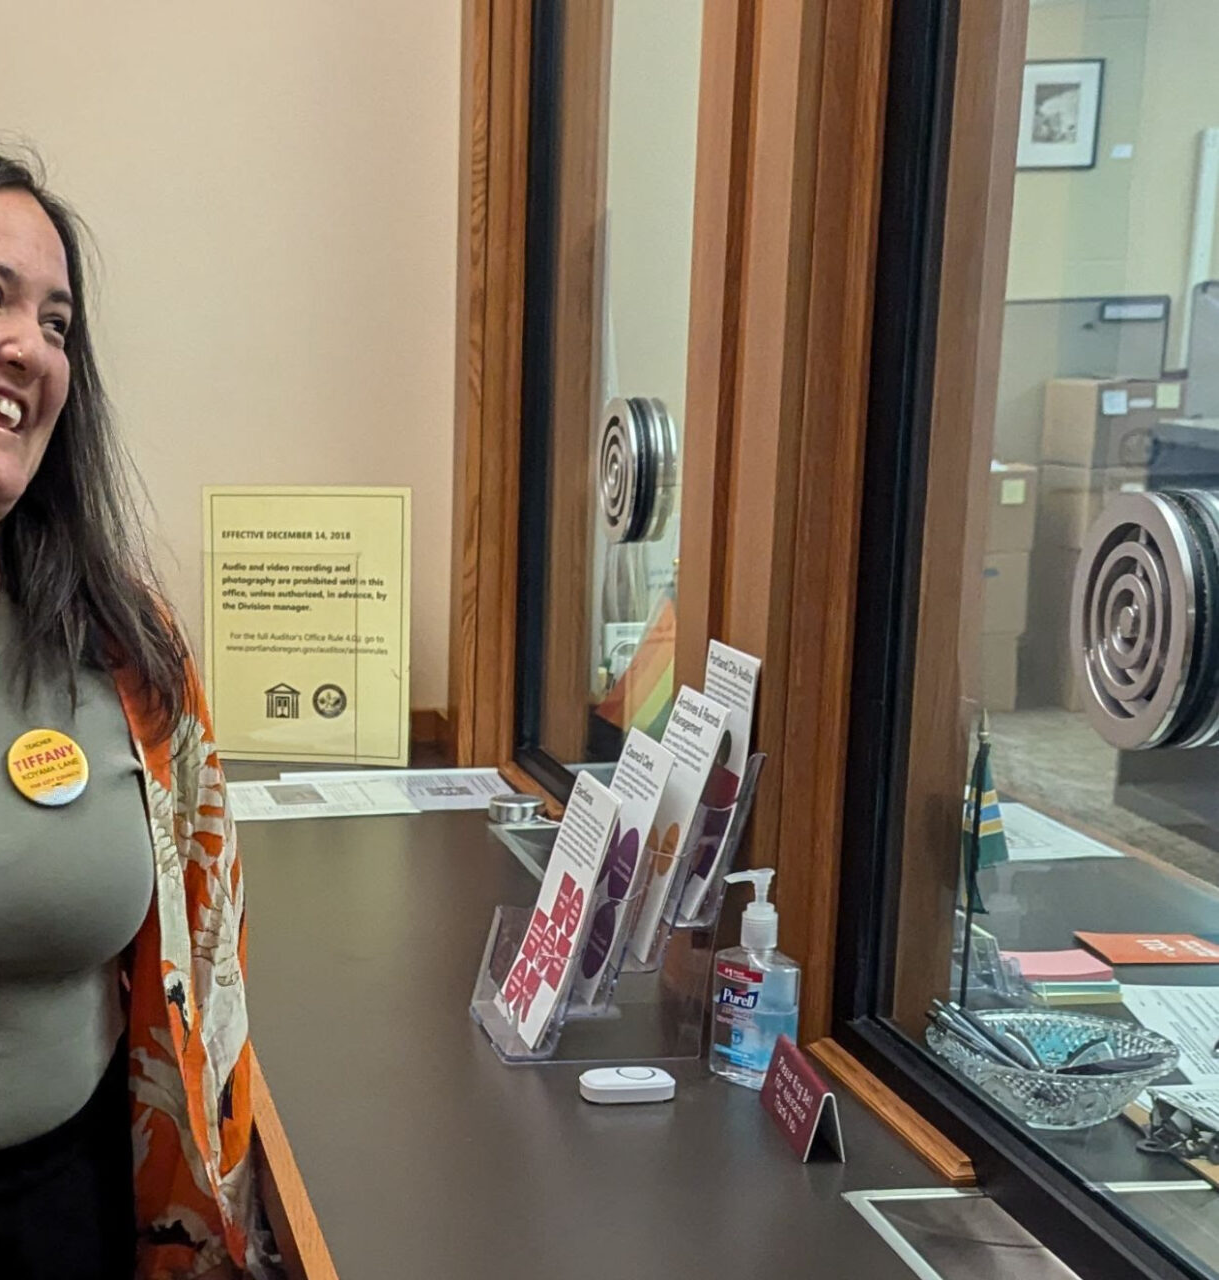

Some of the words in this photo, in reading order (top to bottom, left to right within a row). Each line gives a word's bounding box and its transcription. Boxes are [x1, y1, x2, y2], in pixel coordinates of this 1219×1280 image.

[222, 531, 264, 539] EFFECTIVE
[267, 531, 312, 540] DECEMBER
[315, 531, 328, 541] 14,
[330, 531, 351, 540] 2018
[222, 563, 247, 571] Audio
[249, 563, 264, 572] and
[266, 563, 289, 572] video
[292, 564, 332, 574] recording
[335, 564, 350, 572] and
[222, 576, 275, 586] photography
[293, 577, 337, 587] prohibited
[368, 577, 384, 586] this
[222, 589, 248, 598] office,
[250, 590, 276, 598] unless
[278, 590, 325, 599] authorized,
[376, 591, 387, 601] by
[222, 603, 236, 611] the
[238, 603, 271, 611] Division
[273, 604, 312, 613] manager.
[229, 632, 241, 640] For
[243, 632, 255, 640] the
[257, 632, 268, 640] full
[270, 632, 302, 641] Auditor's
[304, 633, 326, 642] Office
[328, 633, 344, 643] Rule
[365, 636, 375, 644] go
[376, 635, 385, 643] to
[13, 744, 74, 772] TIFFANY
[625, 744, 645, 764] Council
[22, 767, 56, 780] KOYAMA
[57, 758, 79, 770] LANE
[722, 988, 755, 1008] Purell
